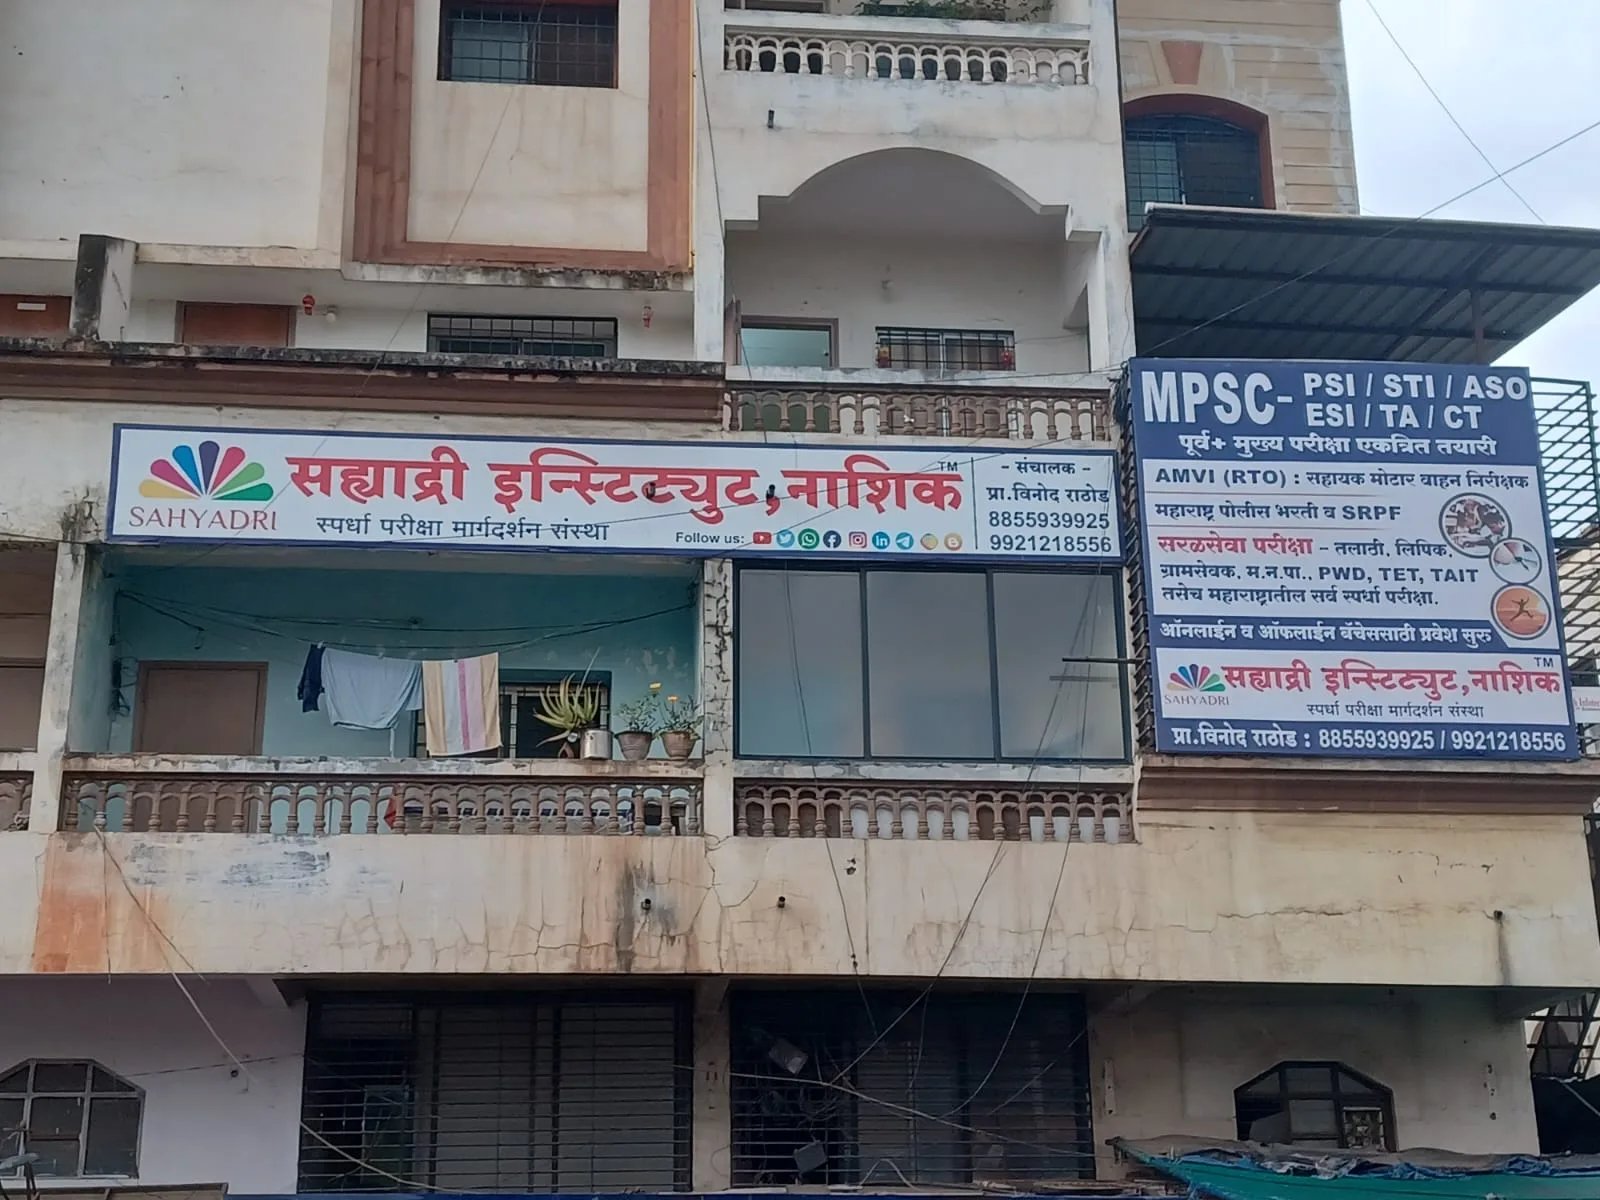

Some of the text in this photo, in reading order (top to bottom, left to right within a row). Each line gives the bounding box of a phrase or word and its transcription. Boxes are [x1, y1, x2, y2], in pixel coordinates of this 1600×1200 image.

[1304, 373, 1355, 397] PSI
[1384, 374, 1435, 398] STI
[1463, 376, 1527, 400] ASO
[1306, 403, 1355, 427] ESI
[1379, 404, 1420, 428] TA
[1443, 405, 1482, 429] CT
[1233, 436, 1284, 458] मुख्य
[1289, 432, 1350, 455] परीक्षा
[1356, 433, 1431, 455] एकत्रित
[1435, 435, 1497, 456] तयारी
[285, 446, 469, 505] सह्याद्री
[1015, 457, 1075, 475] संचालक
[1156, 468, 1215, 484] AMVI
[1223, 469, 1286, 488] (RTO)
[1306, 471, 1365, 488] सहायक
[1370, 468, 1415, 487] मोटार
[1420, 474, 1461, 489] वाहन
[1466, 470, 1529, 490] निरीक्षक
[1065, 483, 1109, 503] राठोड
[128, 506, 277, 531] SAHYADRI
[989, 511, 1109, 530] 8855939925
[1155, 500, 1401, 522] महाराष्ट्र पोलीस भरती व SRPF
[316, 513, 609, 541] स्पर्धा परीक्षा मार्गदर्शन संस्था
[675, 532, 745, 544] Follow us:
[990, 534, 1112, 553] 9921218556
[1157, 531, 1247, 555] सरळसेवा
[1252, 533, 1313, 556] परीक्षा
[1319, 567, 1372, 583] PWD,
[1379, 568, 1424, 584] TET,
[1430, 569, 1479, 582] TAIT
[1162, 583, 1203, 601] तसेच
[1208, 585, 1306, 606] महाराष्ट्रातील
[1311, 585, 1338, 603] सर्व
[1342, 586, 1380, 604] स्पर्धा
[1159, 619, 1237, 641] ऑनलाईन
[1241, 624, 1254, 639] व
[1258, 621, 1336, 642] ऑफलाईन
[1339, 622, 1416, 643] बॅचेससाठी
[1419, 623, 1459, 643] प्रवेश
[1534, 657, 1554, 668] TM
[1221, 658, 1311, 692] सह्याद्री
[1164, 694, 1230, 706] SAHYADRI
[1307, 701, 1484, 718] स्पर्धा परीक्षा मार्गदर्शन संस्था
[1251, 722, 1298, 747] राठोड
[1319, 729, 1435, 749] 8855939925
[1451, 731, 1566, 751] 9921218556
